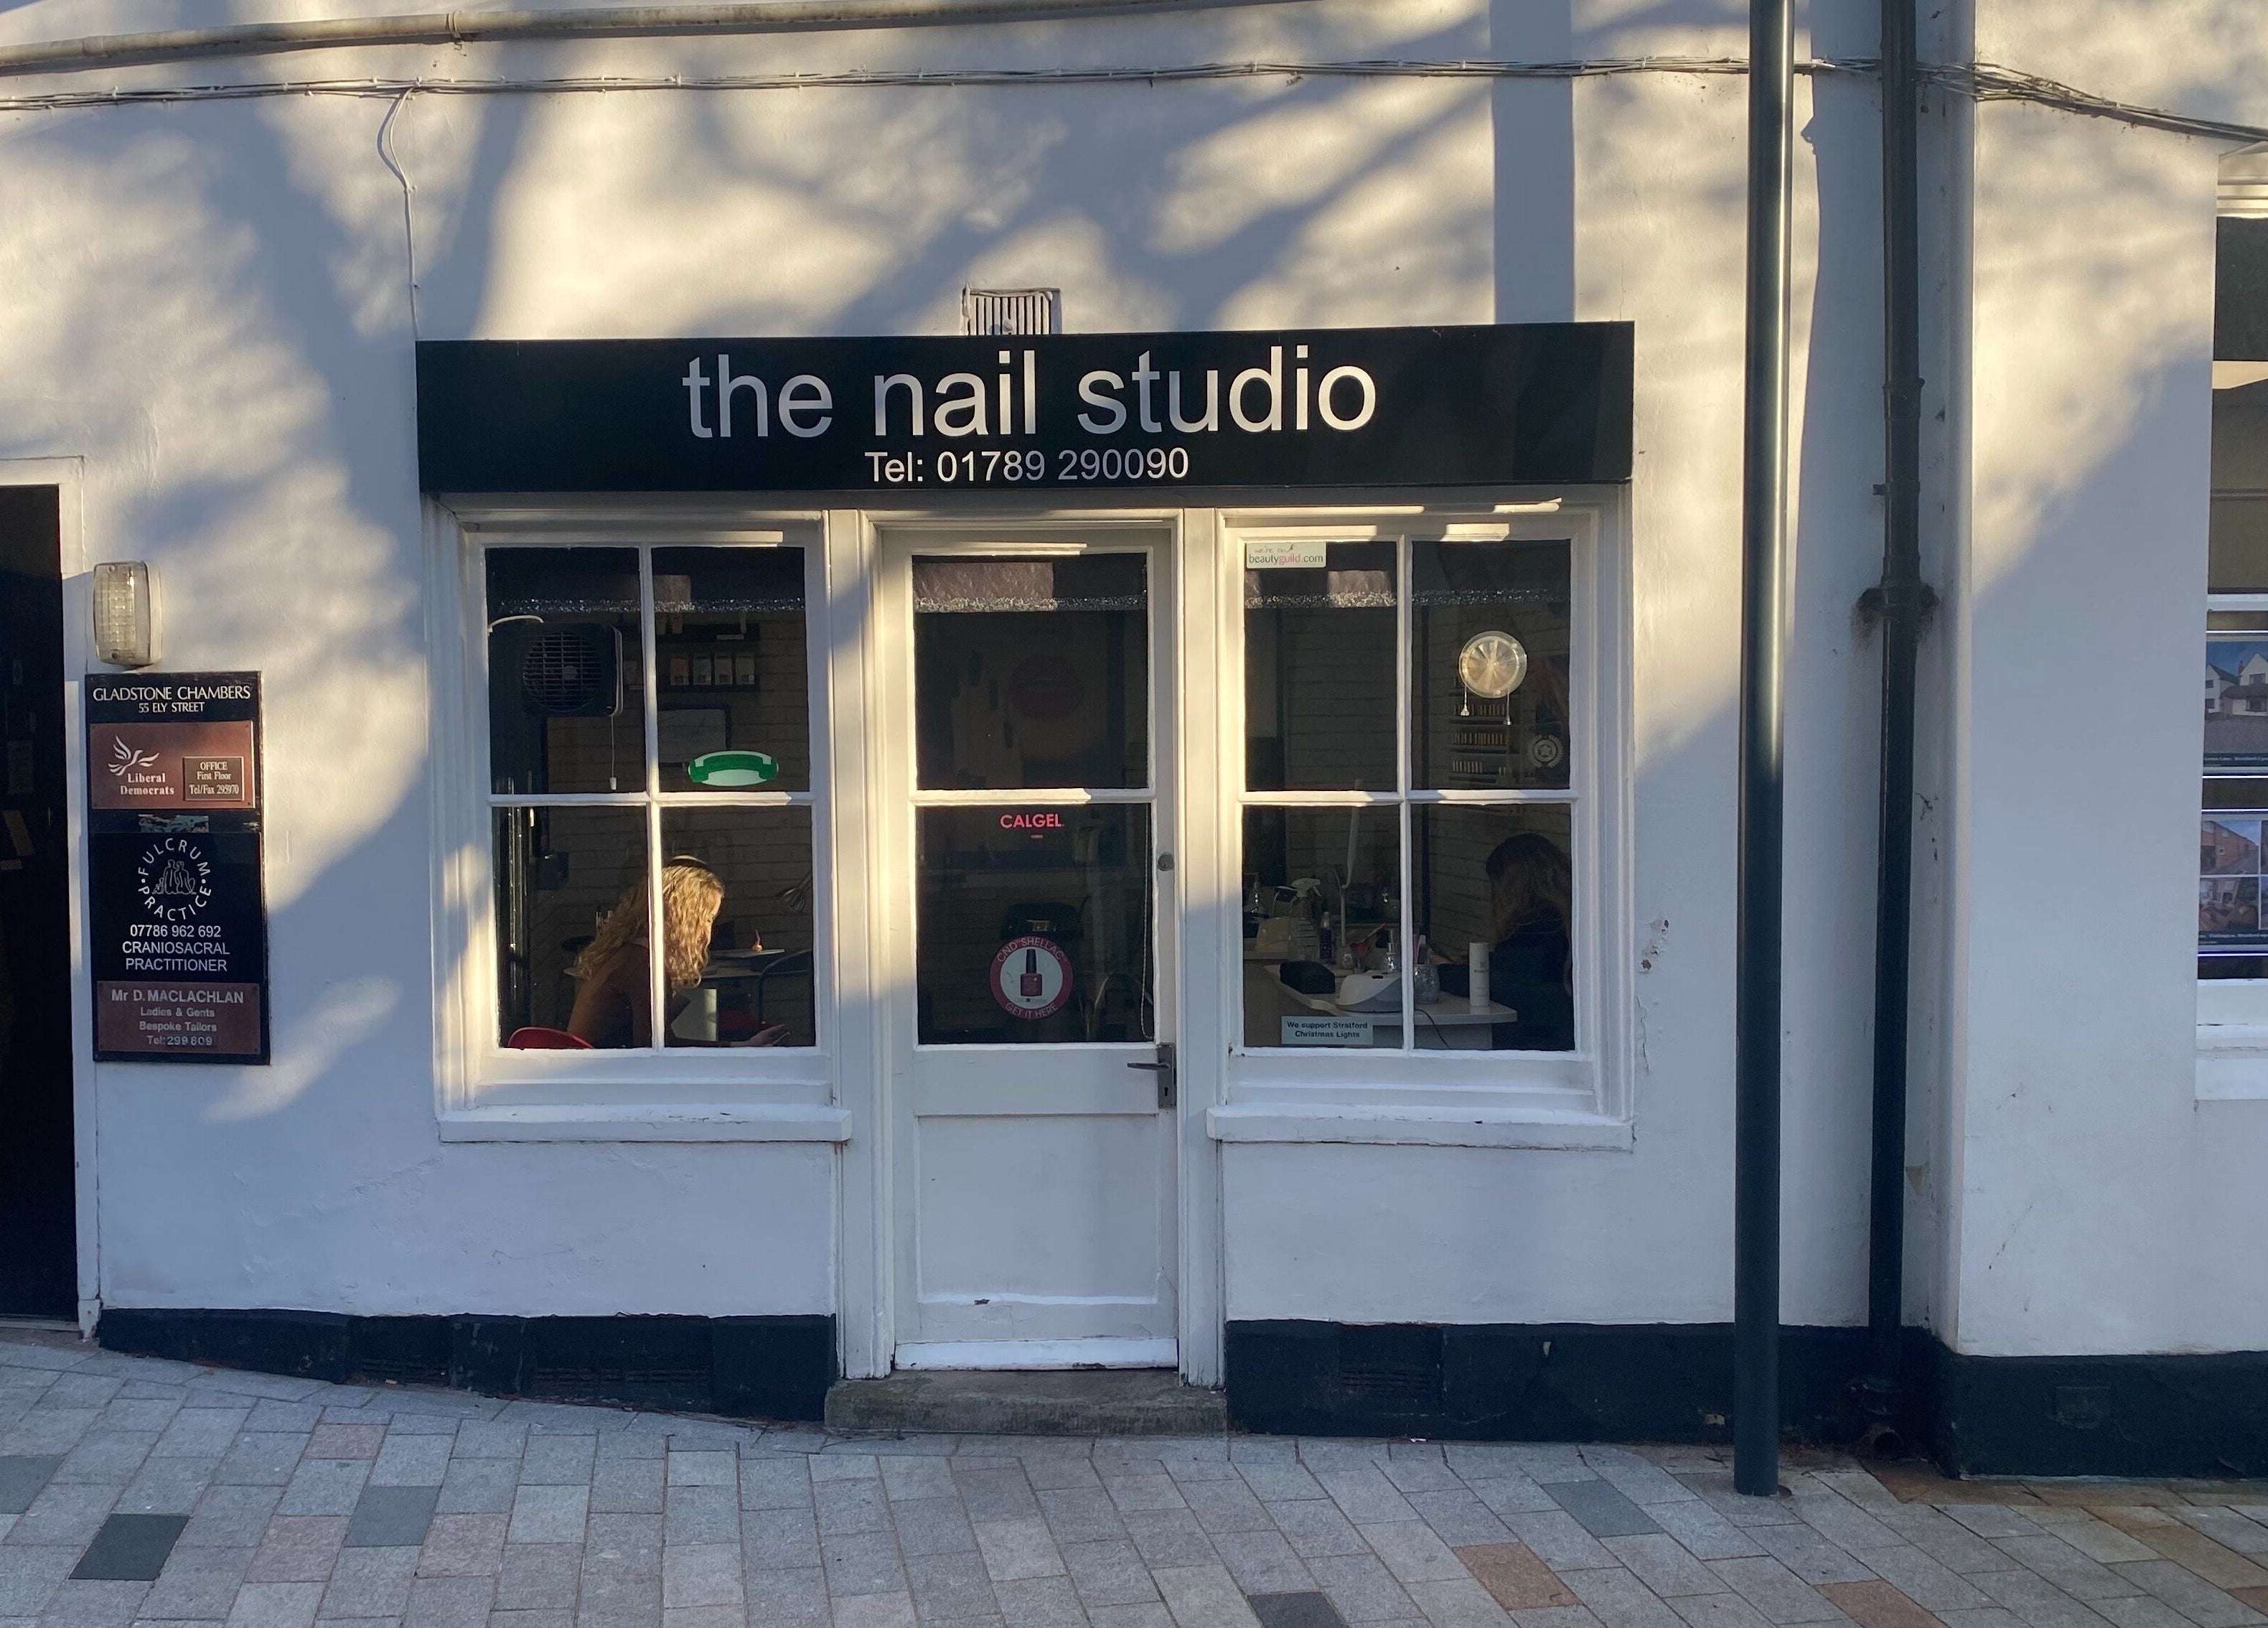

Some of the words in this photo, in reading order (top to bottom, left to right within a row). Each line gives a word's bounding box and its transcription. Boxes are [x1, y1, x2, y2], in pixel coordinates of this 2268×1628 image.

[682, 354, 833, 439] the
[874, 350, 1036, 437] nail
[1077, 345, 1376, 434] studio
[864, 451, 923, 482] Tel:
[937, 450, 1046, 482] 01789
[1058, 447, 1189, 480] 290090
[1249, 553, 1323, 565] beautyguild.com
[93, 686, 172, 701] GLADSTONE
[177, 686, 251, 700] CHAMBERS
[139, 702, 149, 713] 55
[153, 703, 168, 713] ELY
[172, 701, 205, 713] STREET
[200, 761, 228, 771] OFFICE
[127, 772, 166, 783] Liberal
[197, 771, 212, 780] First
[214, 771, 232, 780] Floor
[120, 785, 174, 795] Democrats
[189, 784, 215, 795] Tel/Fax
[217, 784, 240, 795] 295970
[1000, 813, 1062, 828] CALGEL
[138, 838, 211, 876] FULCRUM
[138, 886, 212, 922] PRACTICE
[130, 924, 168, 937] 07786
[172, 925, 195, 937] 962
[198, 925, 222, 937] 692
[122, 941, 230, 955] CRANIOSACRAL
[997, 942, 1018, 962] CND
[1021, 937, 1064, 960] SHELLAC
[126, 958, 228, 972] PRACTITIONER
[111, 989, 128, 1001] Mr
[133, 990, 146, 1002] D.
[147, 990, 244, 1004] MACLACHLAN
[140, 1006, 172, 1016] Ladies
[175, 1007, 183, 1016] &
[187, 1007, 215, 1017] Gents
[1006, 1002, 1022, 1016] GET
[1025, 1009, 1033, 1018] IT
[1035, 1003, 1058, 1018] HERE
[139, 1020, 182, 1032] Bespoke
[184, 1021, 217, 1032] Tailors
[1336, 1031, 1360, 1039] Lights
